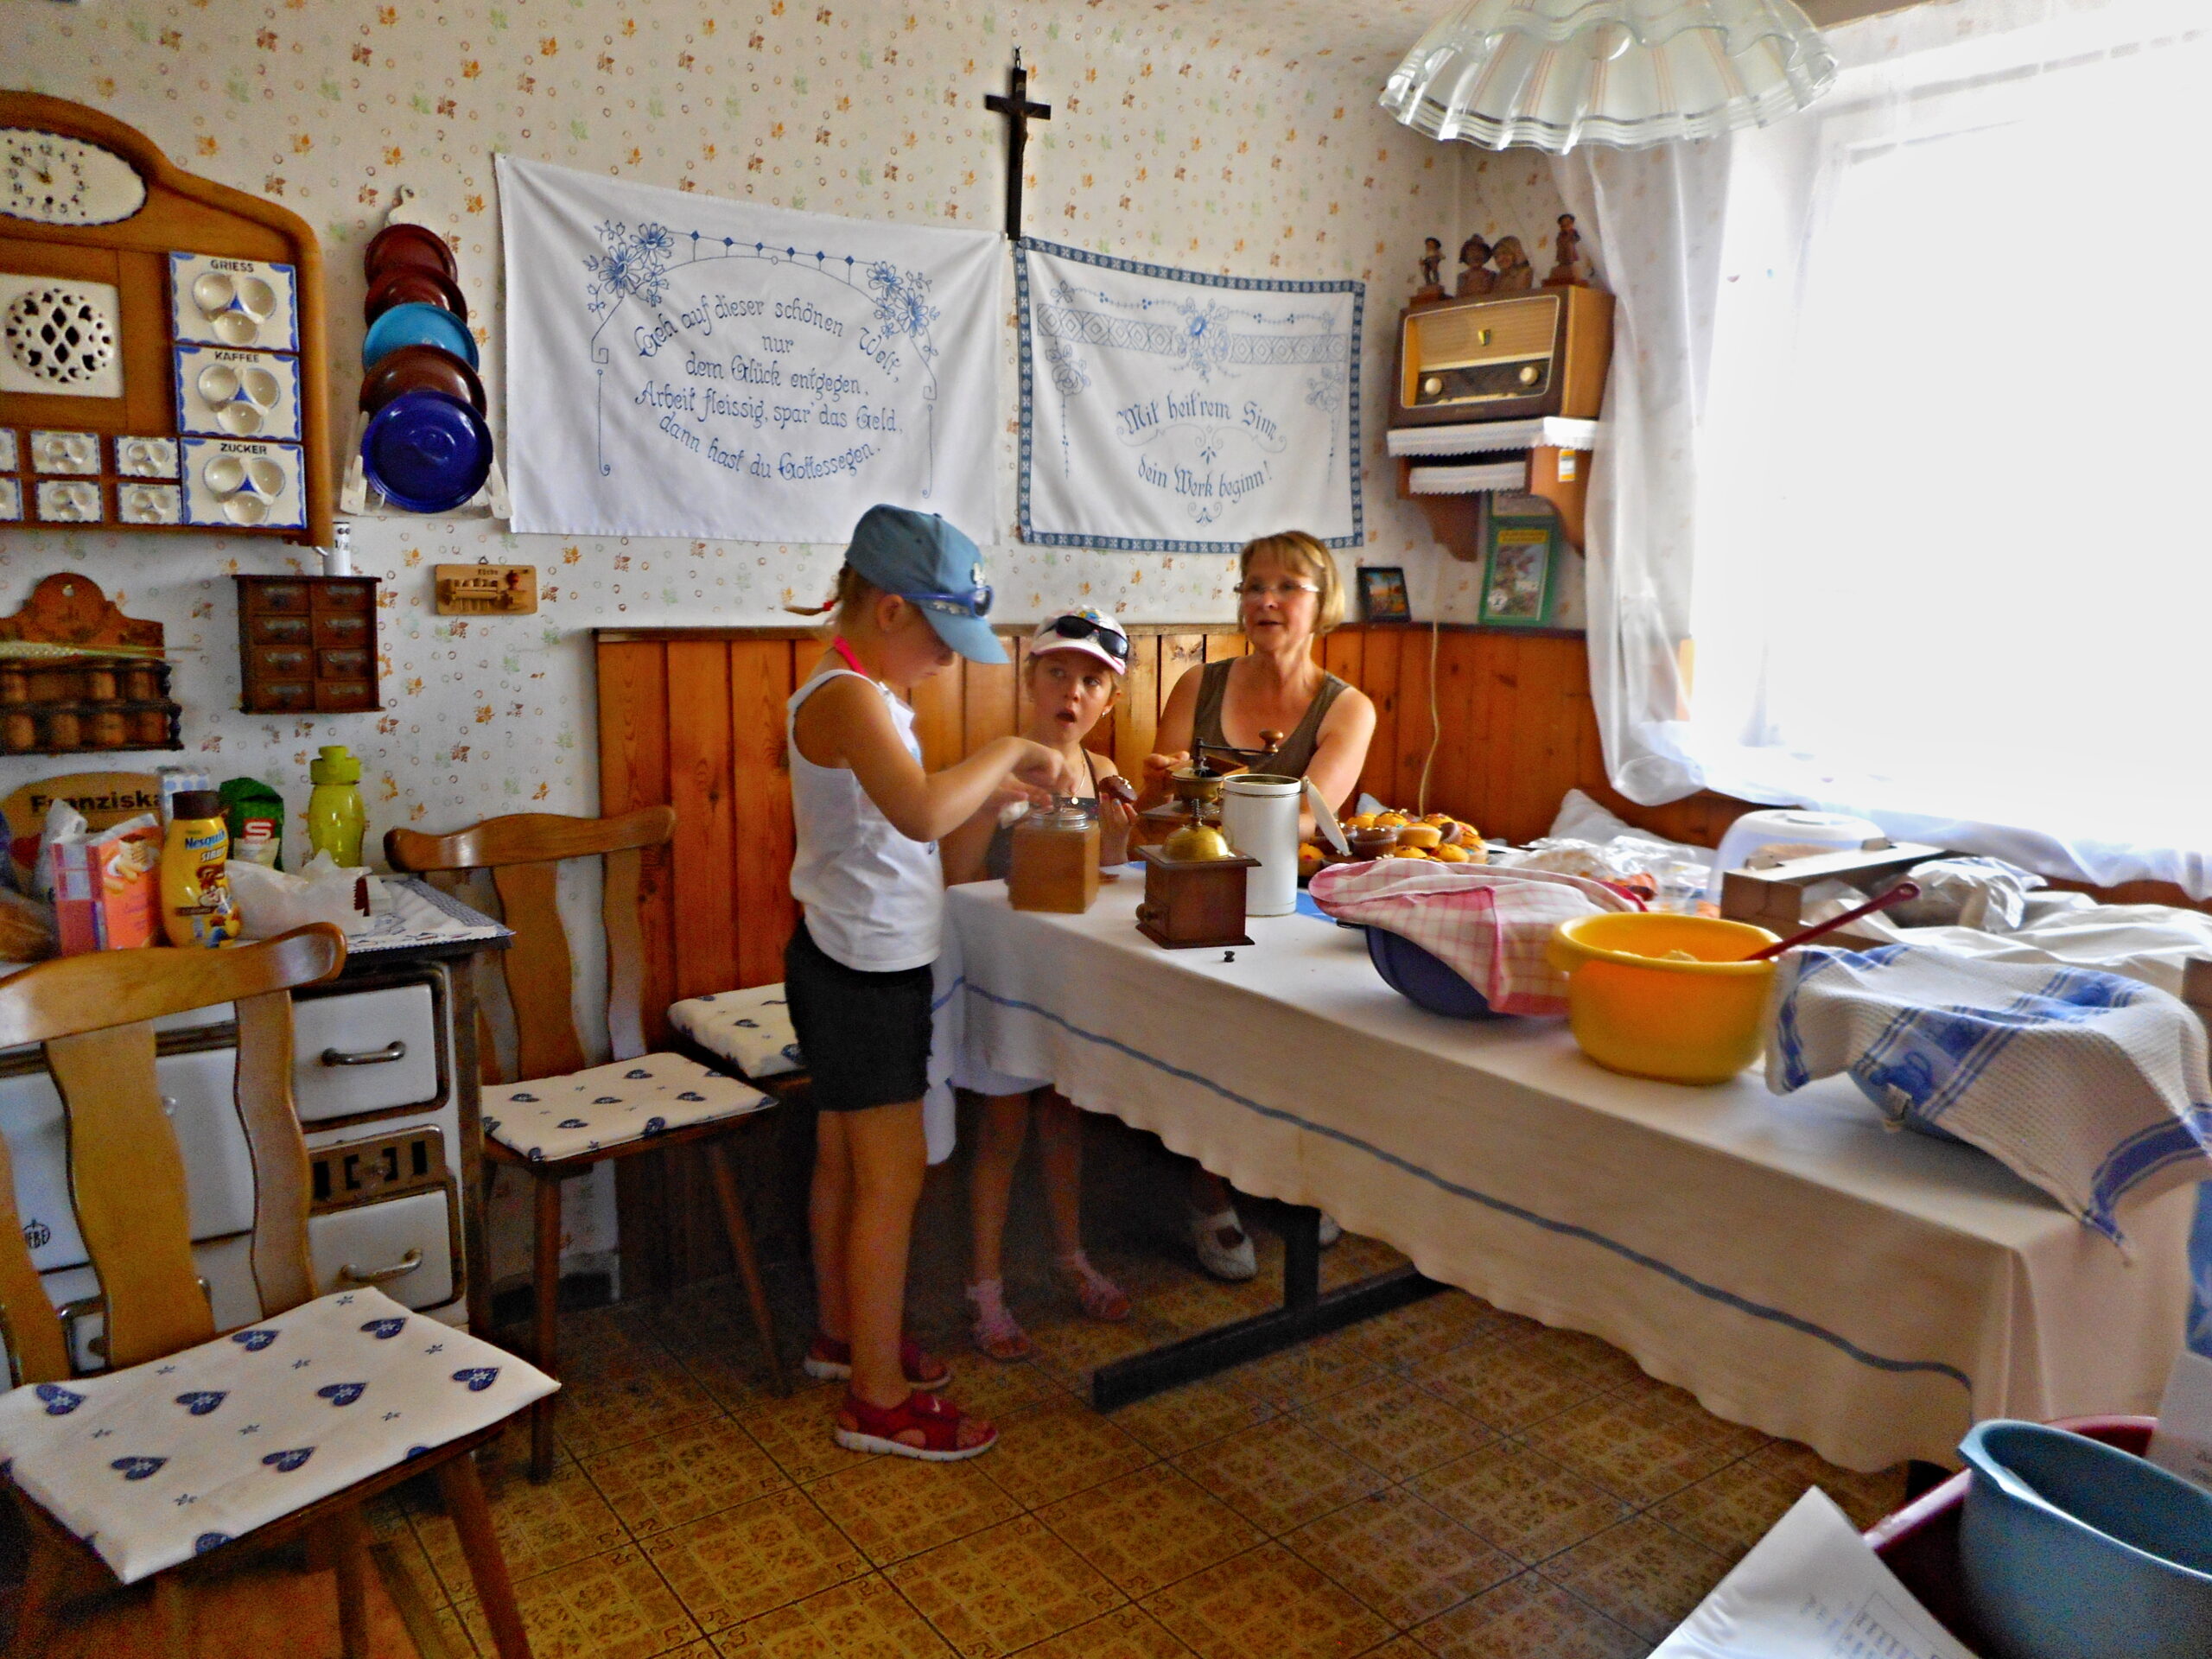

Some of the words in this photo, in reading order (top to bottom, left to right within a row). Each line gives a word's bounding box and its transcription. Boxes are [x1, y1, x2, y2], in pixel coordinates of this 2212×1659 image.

[71, 162, 80, 175] 2
[210, 259, 255, 273] GRIESS
[634, 313, 678, 358] Geh
[681, 295, 712, 336] auf
[715, 295, 765, 320] dieser
[774, 297, 844, 337] schönen
[762, 334, 794, 354] nur
[214, 351, 260, 364] KAFFEE
[685, 351, 725, 380] dem
[731, 354, 782, 387] Glück
[791, 367, 869, 402] entgegen.
[635, 380, 696, 411] Arbeit
[697, 388, 768, 429] fleissig,
[819, 404, 848, 429] das
[1117, 399, 1160, 435] Mit
[1242, 400, 1277, 442] Sinn
[219, 442, 267, 455] ZUCKER
[659, 411, 699, 454] dann
[707, 437, 745, 472] hast
[750, 453, 772, 479] du
[778, 442, 881, 481] Gottessegen.
[1137, 453, 1168, 489] dein
[1173, 462, 1214, 498] Werk
[1217, 460, 1273, 505] beginn!
